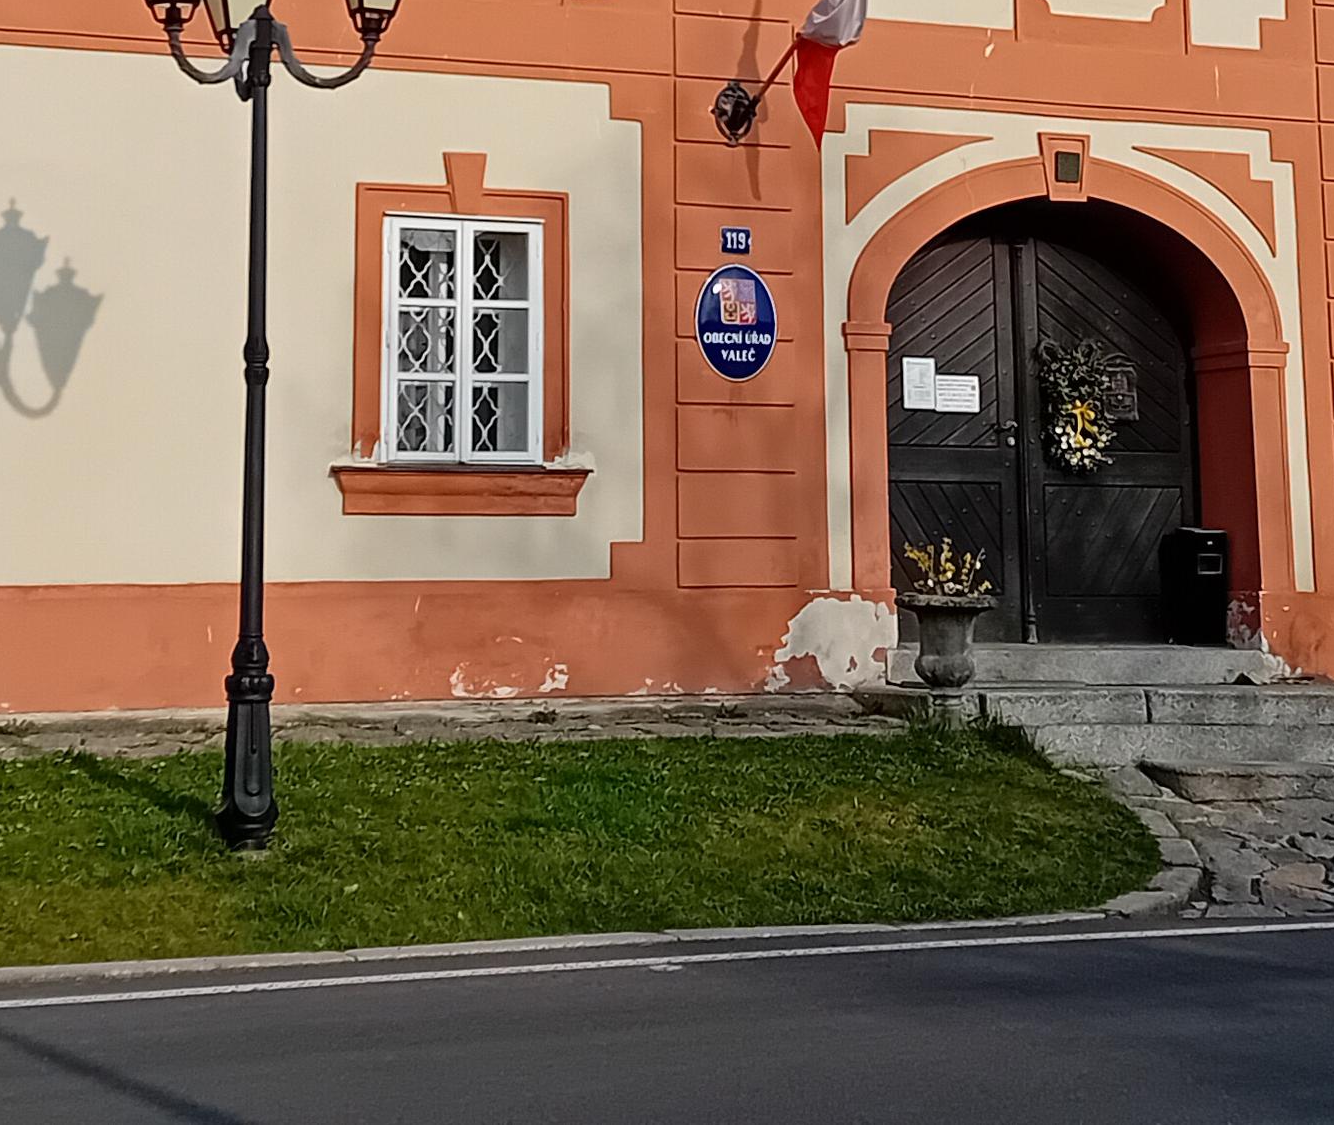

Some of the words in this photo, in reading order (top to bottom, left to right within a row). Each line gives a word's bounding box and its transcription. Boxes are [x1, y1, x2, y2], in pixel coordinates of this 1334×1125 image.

[725, 231, 746, 250] 119
[703, 330, 743, 344] OBECNÍ
[744, 330, 772, 345] ÚŘAD
[721, 347, 756, 362] VALEČ
